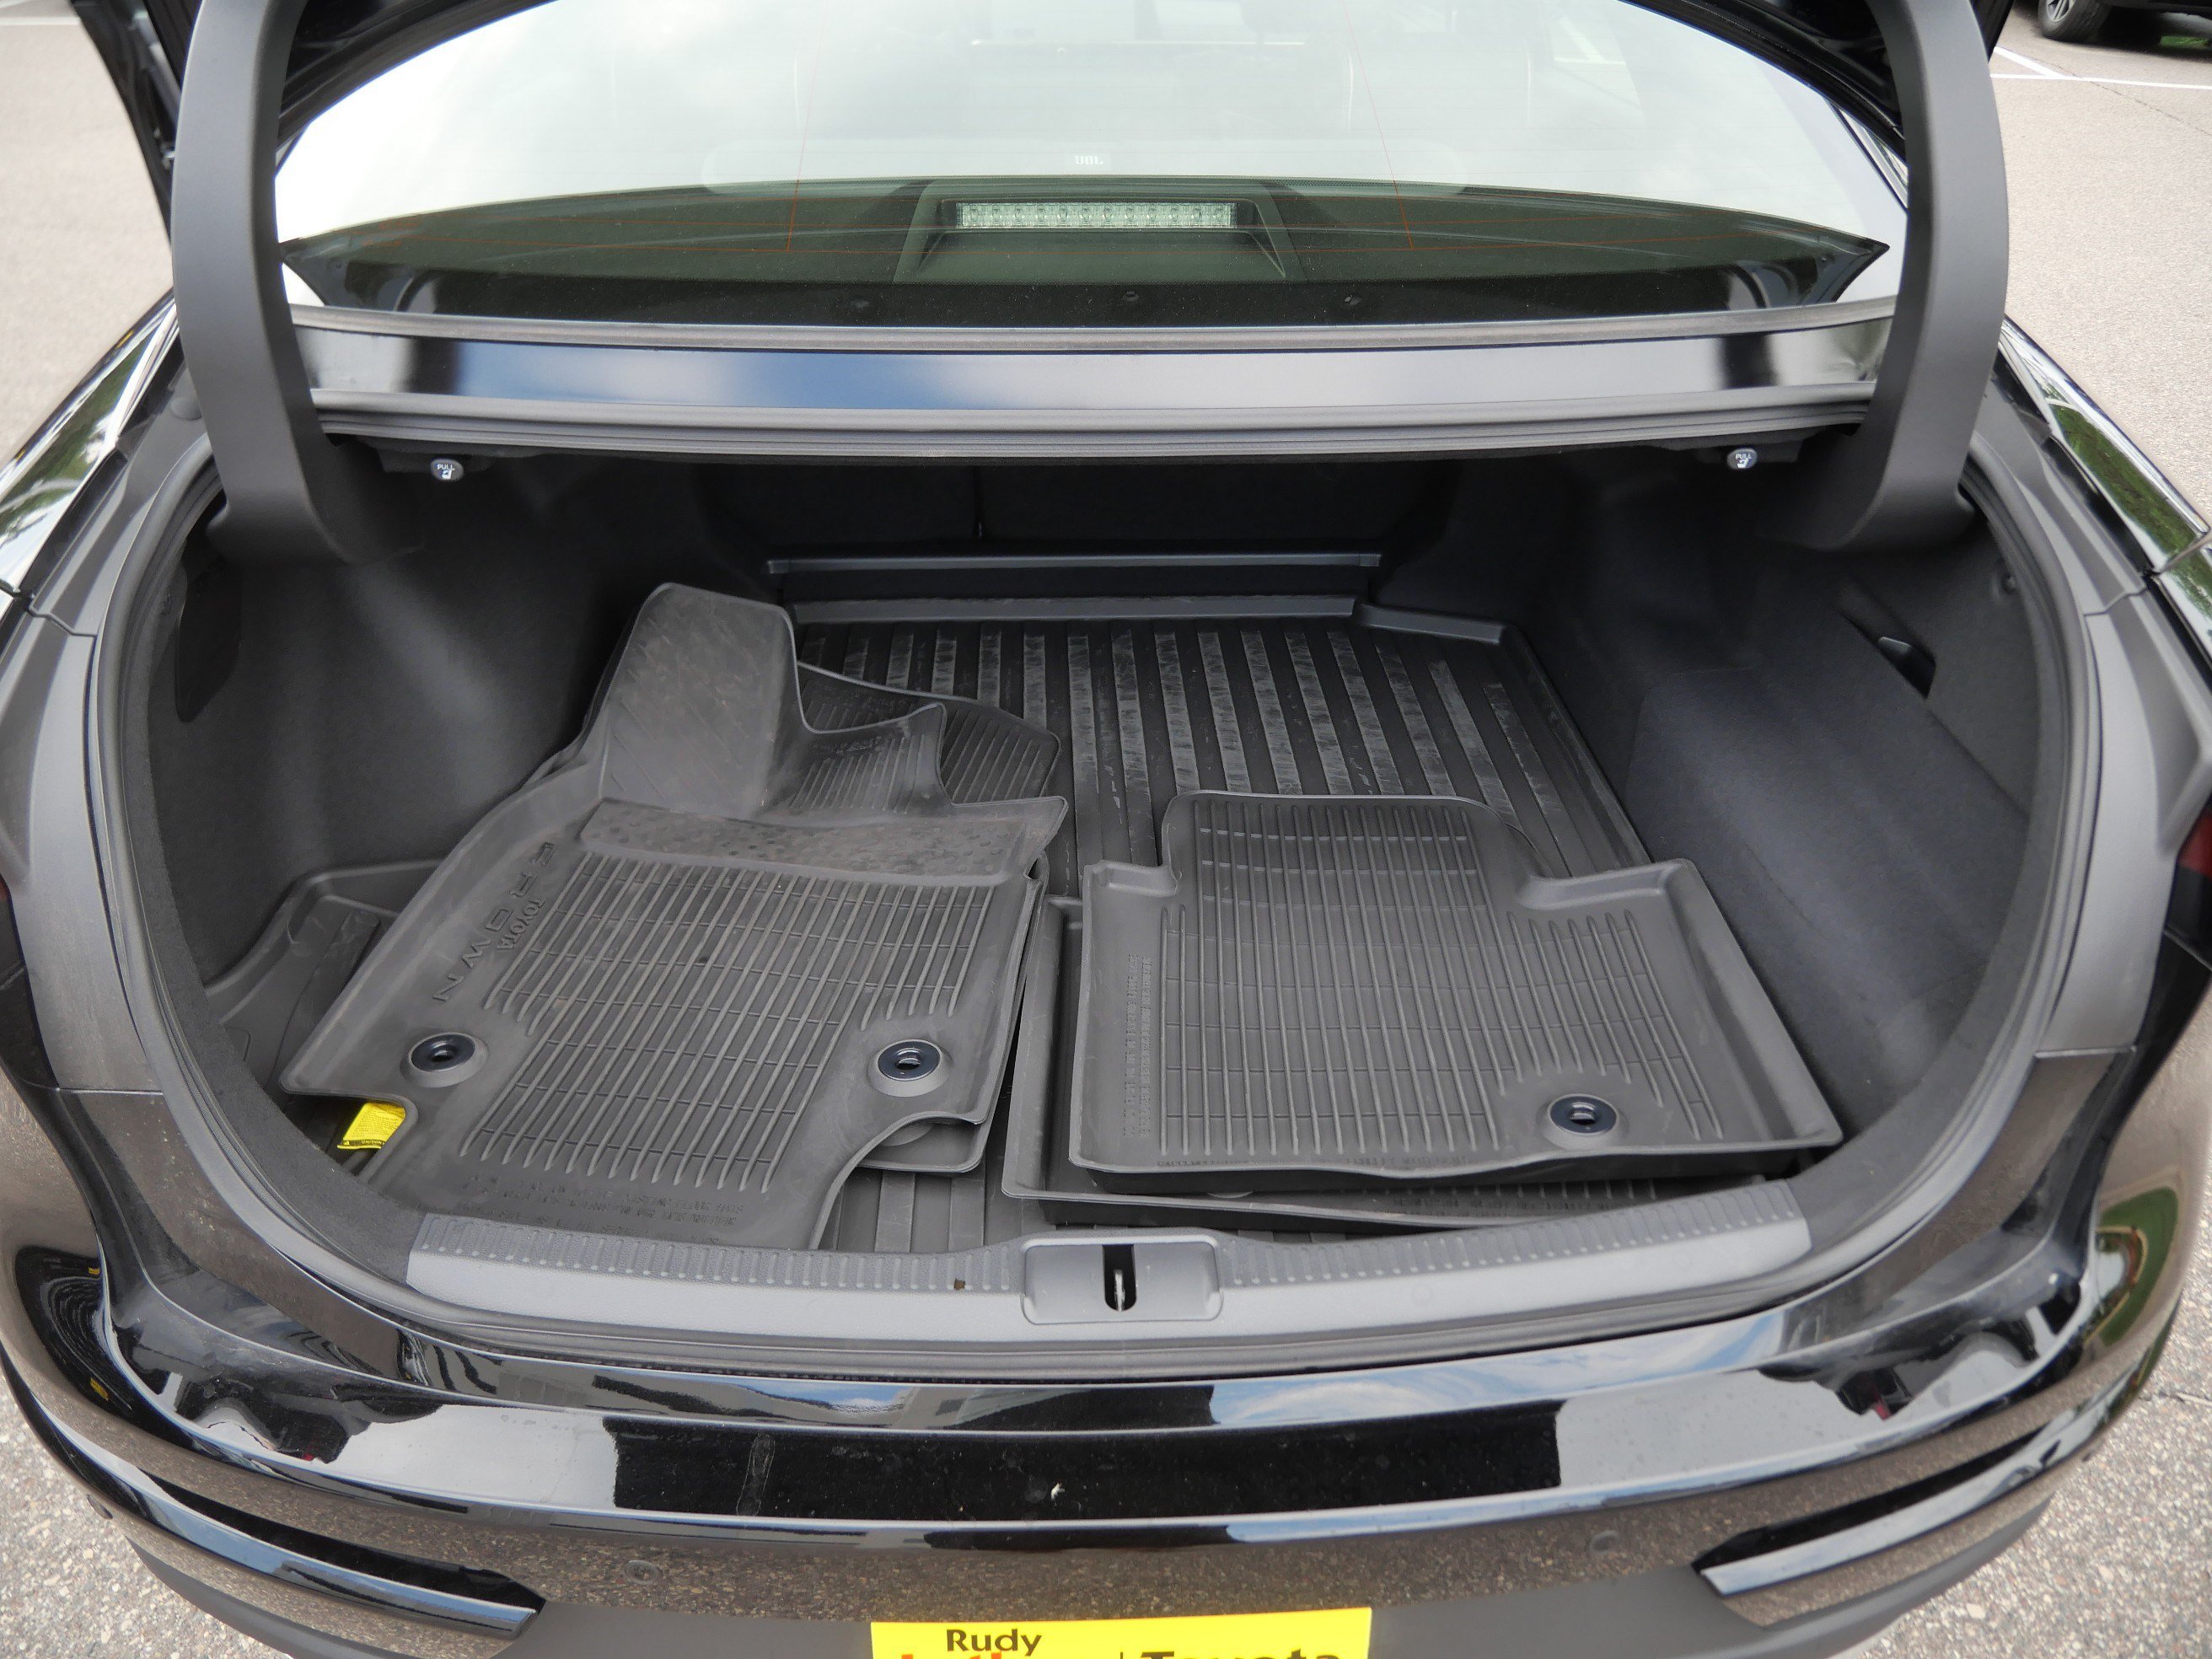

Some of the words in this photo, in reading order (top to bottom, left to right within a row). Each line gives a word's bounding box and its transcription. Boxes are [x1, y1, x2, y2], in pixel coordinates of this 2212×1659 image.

[1074, 155, 1103, 165] JBL
[496, 896, 545, 950] TOYOTA
[946, 1628, 1043, 1656] Rudy
